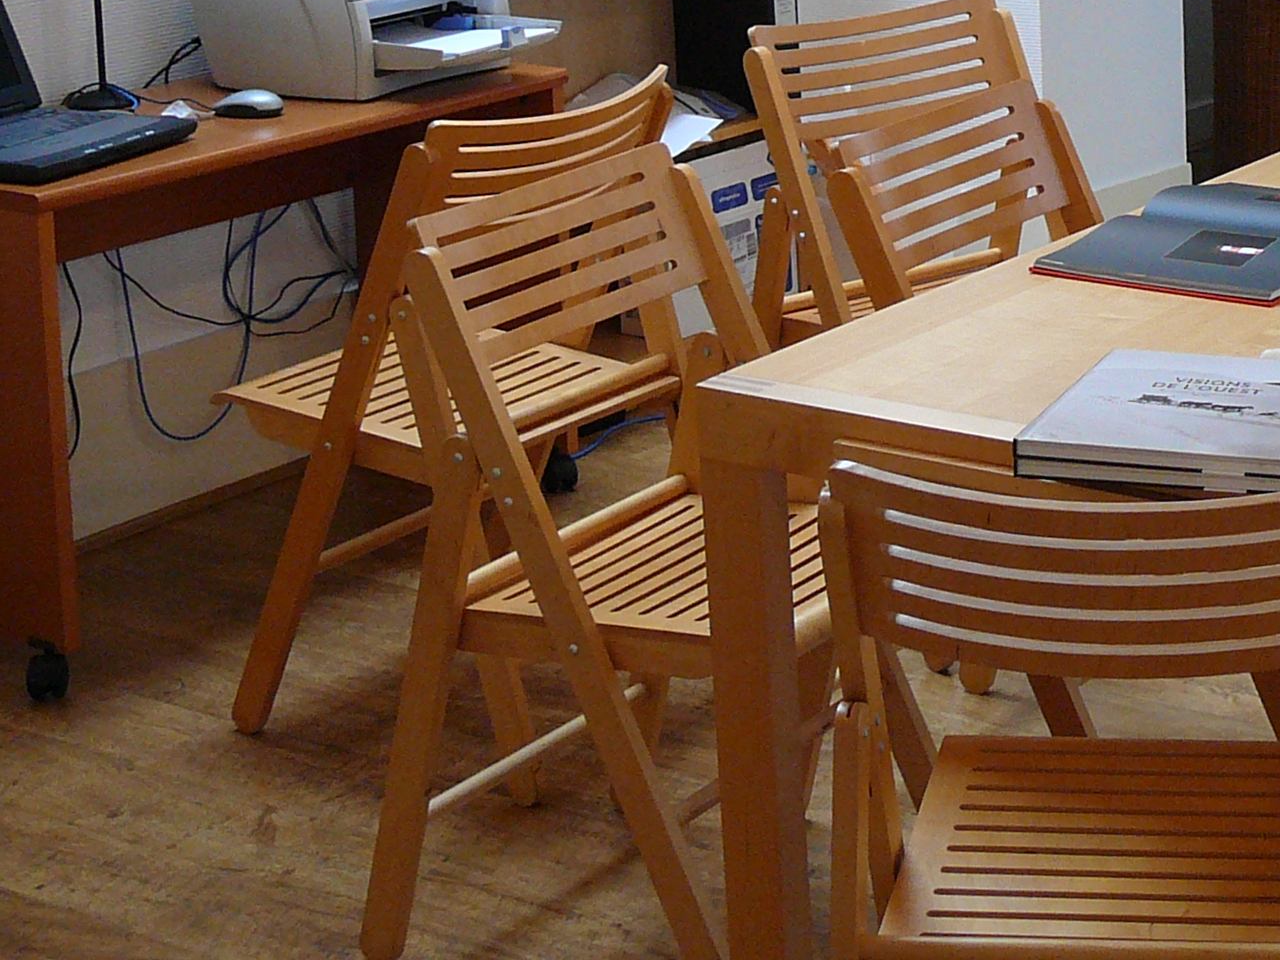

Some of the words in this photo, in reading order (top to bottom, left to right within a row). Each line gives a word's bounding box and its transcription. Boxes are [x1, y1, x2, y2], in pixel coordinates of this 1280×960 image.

[1152, 381, 1179, 389] DE
[1183, 384, 1263, 395] L'OUEST
[1176, 377, 1252, 388] VISIONS
